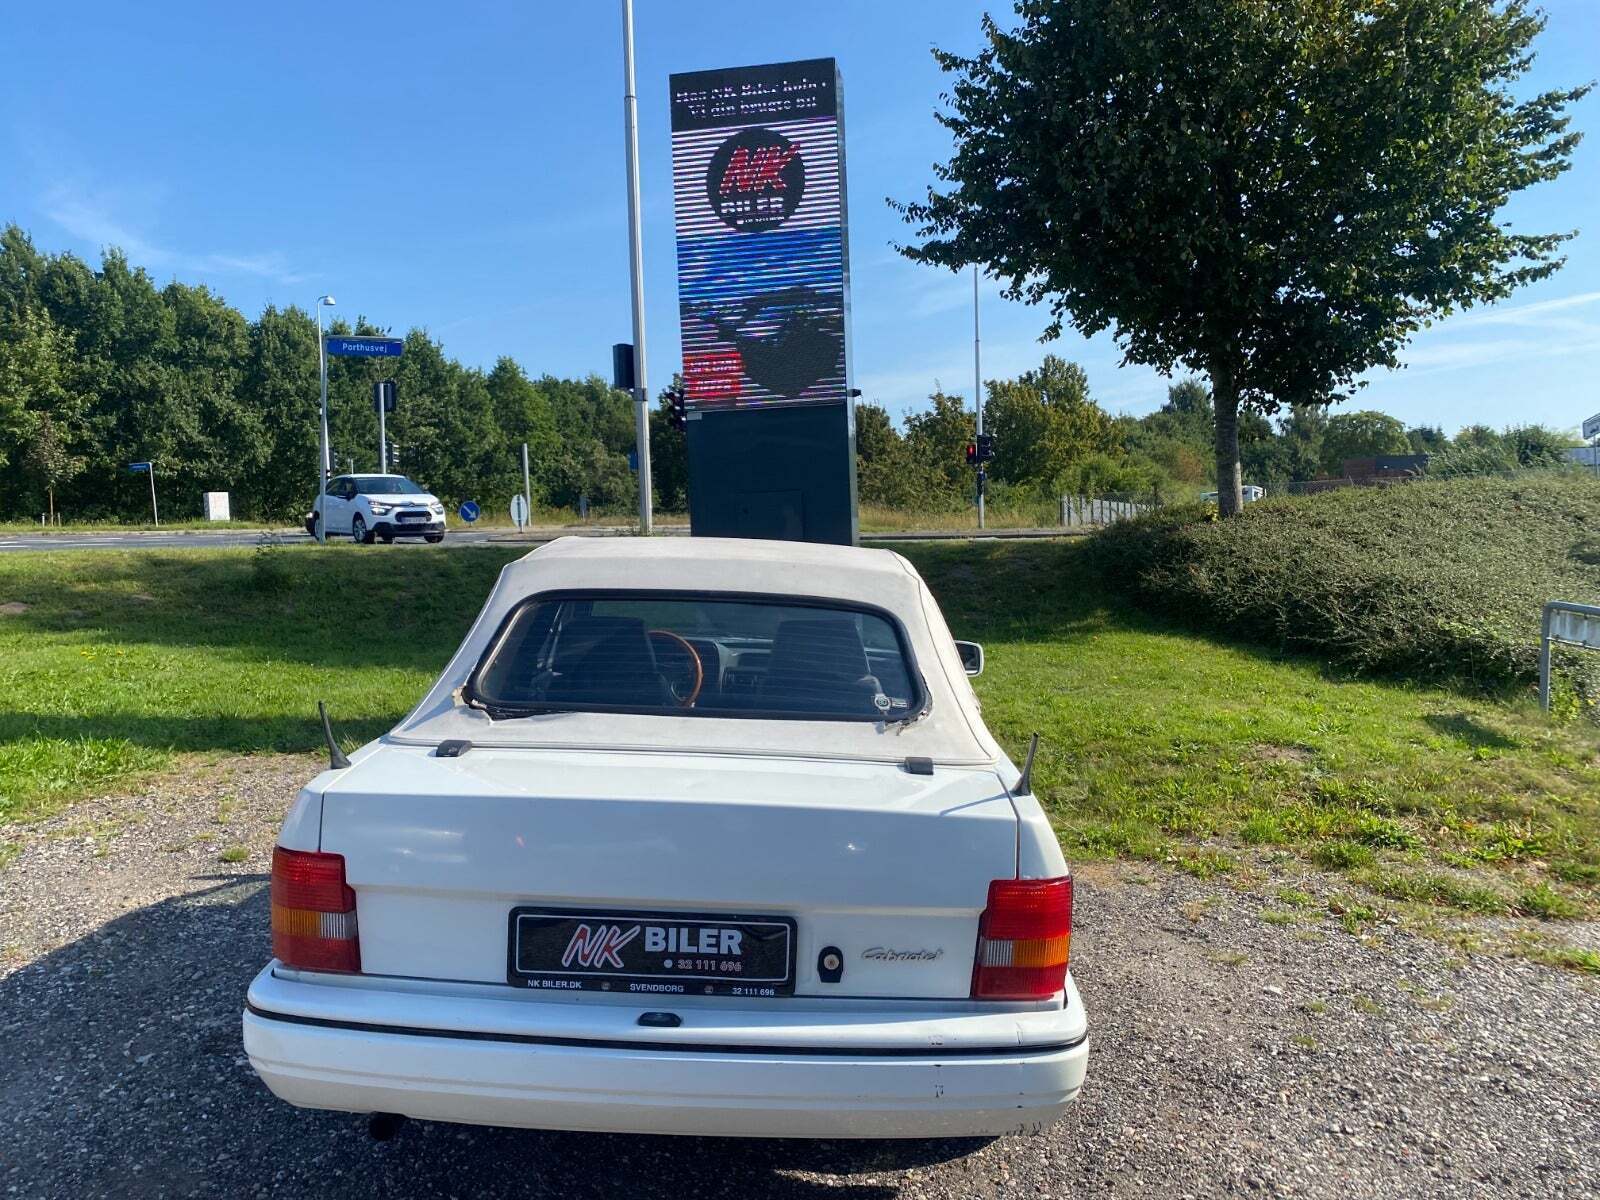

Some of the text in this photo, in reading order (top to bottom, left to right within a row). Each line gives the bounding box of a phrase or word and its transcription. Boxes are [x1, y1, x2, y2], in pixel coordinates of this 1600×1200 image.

[719, 142, 801, 195] NK
[342, 343, 388, 353] Porthusvej
[561, 923, 743, 969] NK BILER
[677, 959, 742, 972] 32 111 696
[527, 980, 582, 989] NK BILER.DK
[629, 983, 685, 993] SVENDBORG
[731, 987, 775, 996] 32 111 696
